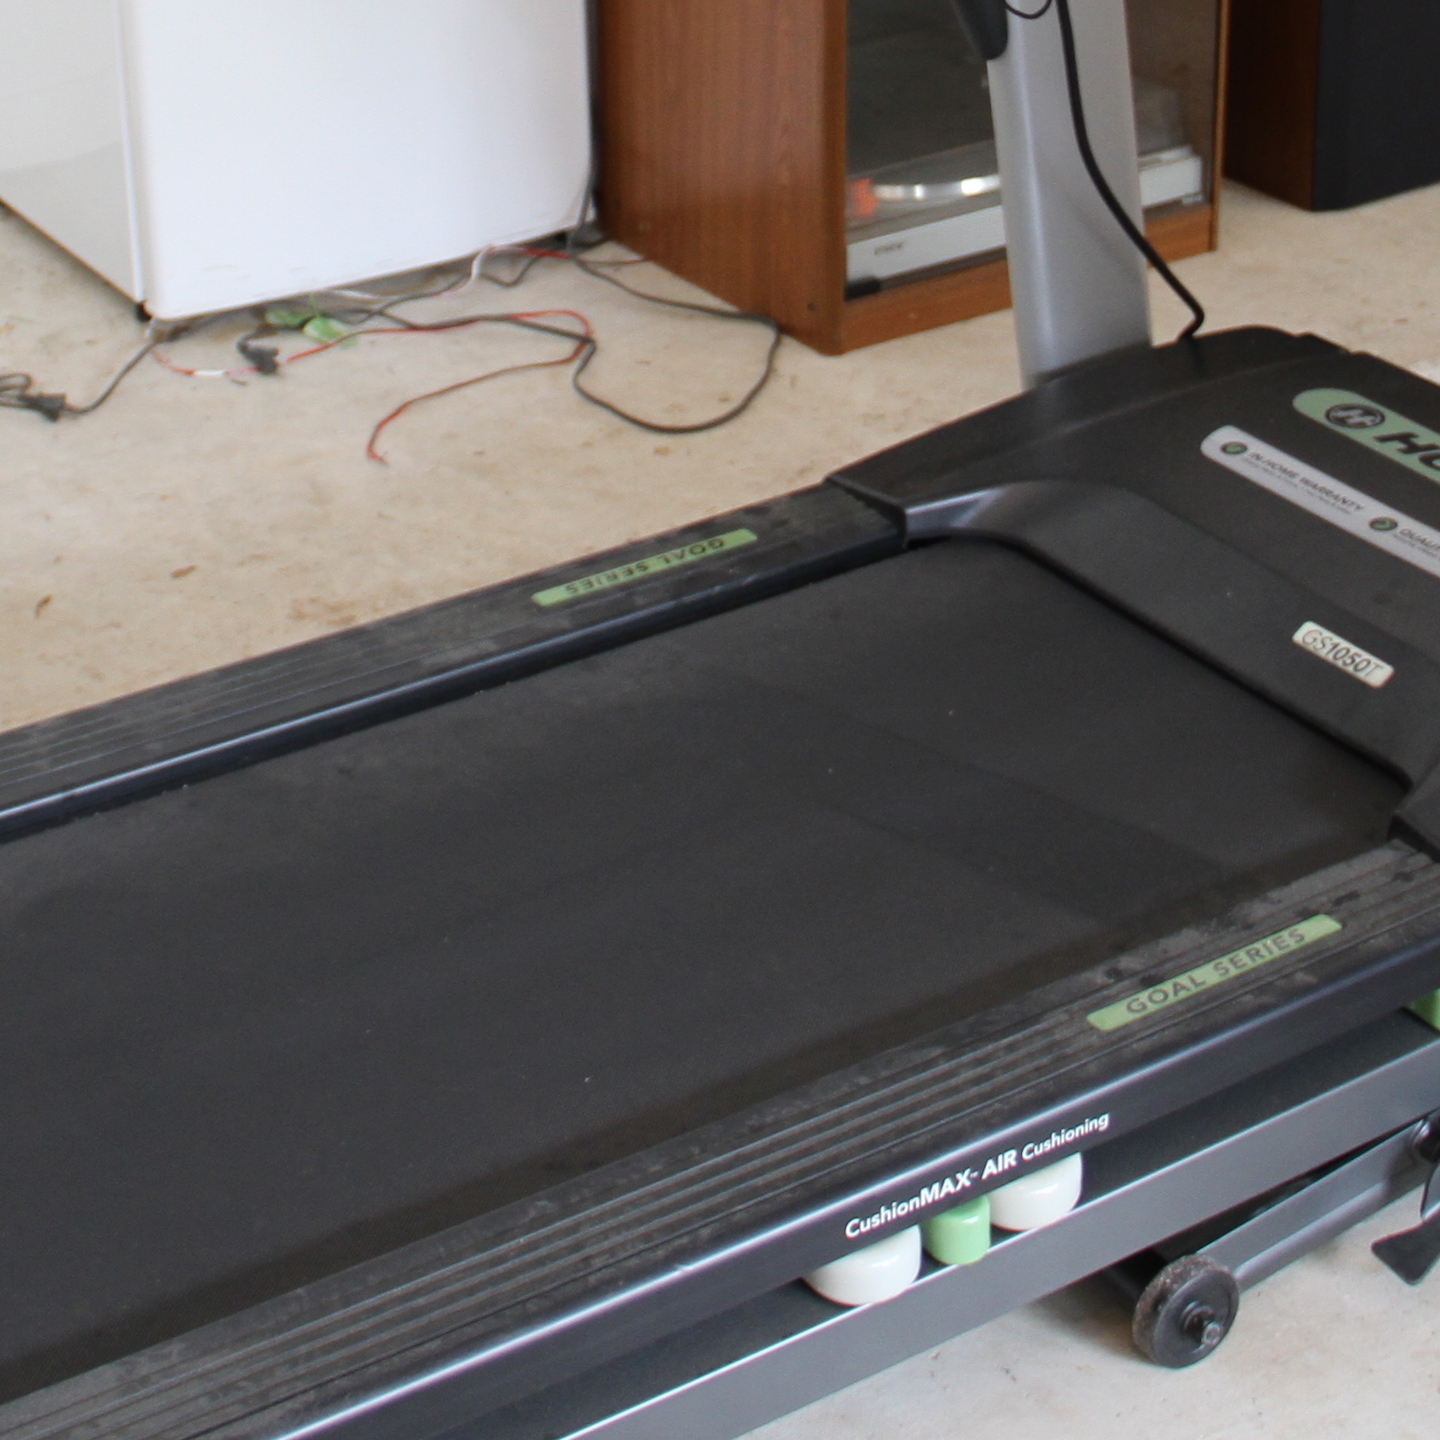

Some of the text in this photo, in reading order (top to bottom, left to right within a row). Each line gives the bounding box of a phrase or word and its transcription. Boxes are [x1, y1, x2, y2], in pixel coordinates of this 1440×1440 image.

[1299, 475, 1366, 511] WARRANTY
[564, 538, 725, 595] GOAL SERIES
[1302, 629, 1385, 678] GS1050T
[1125, 927, 1306, 1014] GOAL SERIES
[980, 1149, 1018, 1181] AIR
[1021, 1112, 1110, 1161] Cushioning
